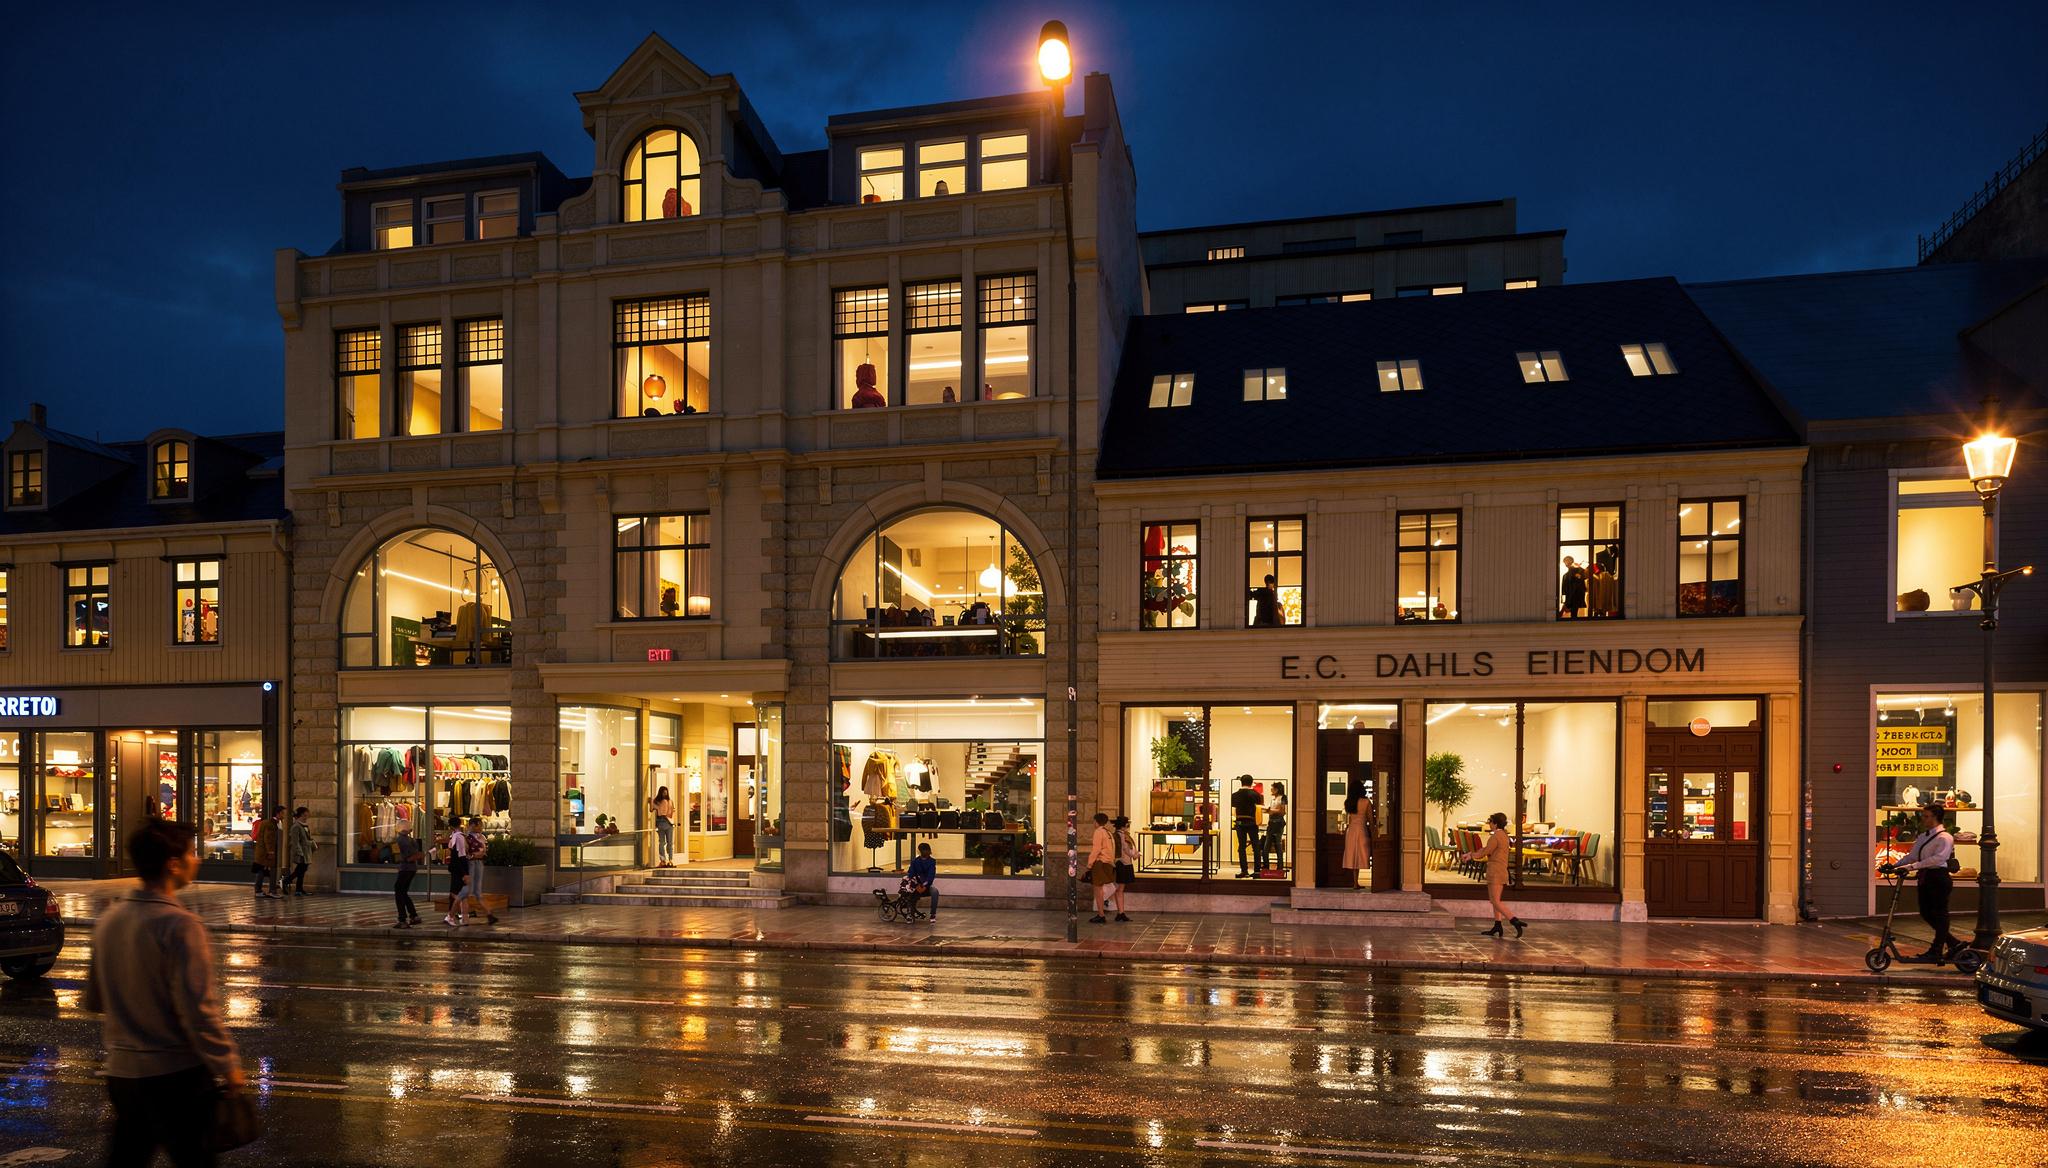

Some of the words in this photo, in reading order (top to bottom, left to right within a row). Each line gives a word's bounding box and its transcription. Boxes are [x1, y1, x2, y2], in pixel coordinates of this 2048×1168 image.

[1281, 655, 1347, 679] E.C.
[1375, 651, 1494, 678] DAHLS
[1527, 648, 1705, 675] EIENDOM
